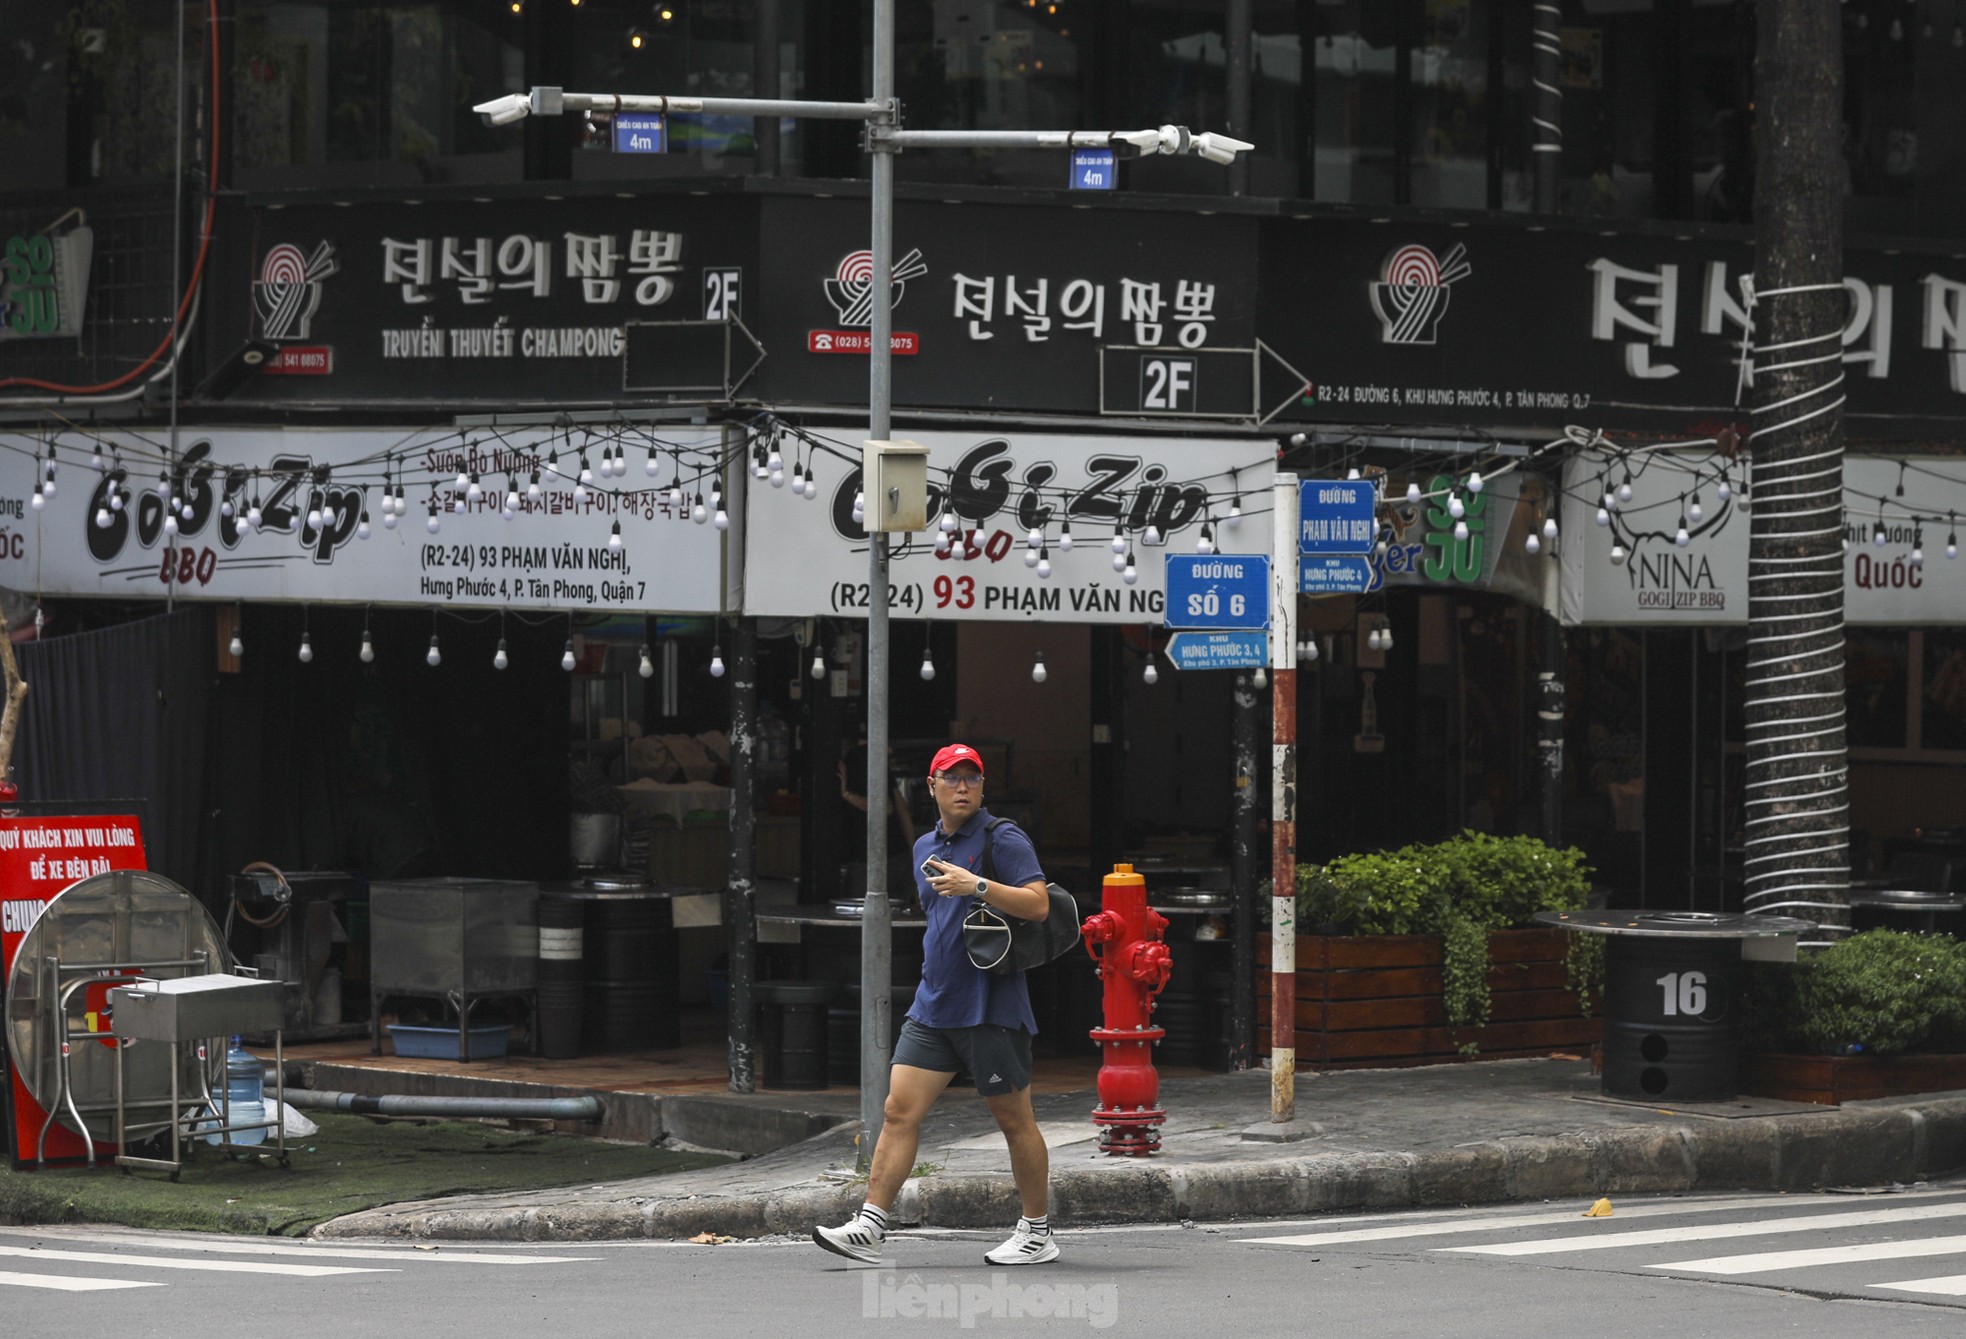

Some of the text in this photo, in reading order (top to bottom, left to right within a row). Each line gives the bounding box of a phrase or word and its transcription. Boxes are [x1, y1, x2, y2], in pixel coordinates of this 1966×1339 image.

[630, 133, 652, 150] 4m
[1083, 169, 1103, 186] 4m
[564, 229, 684, 305] 짬뽕
[706, 271, 739, 320] 2F
[1120, 277, 1216, 349] 짬뽕
[382, 315, 626, 358] TRUYỀN THUYẾT CHAMPONG
[836, 336, 862, 349] (028)
[284, 353, 299, 367] 541
[301, 353, 325, 367] 08075
[1144, 360, 1192, 409] 2F
[1318, 385, 1350, 401] R2-24
[1354, 383, 1390, 402] ĐƯỜNG
[1393, 388, 1402, 406] 6,
[1405, 388, 1425, 403] KHU
[1428, 388, 1454, 405] HƯNG
[1457, 387, 1491, 406] PHƯỚC
[1493, 391, 1501, 409] 4,
[1517, 388, 1534, 408] TÂN
[1537, 391, 1568, 409] PHONG
[1574, 393, 1590, 410] Q.7
[1067, 454, 1209, 547] Zip
[1318, 485, 1357, 504] ĐƯỜNG
[256, 453, 366, 566] Zip
[1303, 516, 1371, 547] PHẠM VĂN NGHỊ
[159, 546, 217, 587] BBQ
[421, 542, 631, 576] (R2-24) 93 PHẠM VĂN NGHỊ,
[1192, 560, 1244, 579] ĐƯỜNG
[1305, 566, 1362, 581] HƯNG PHƯỚC 4
[1640, 553, 1724, 590] NINA
[1855, 553, 1923, 591] Quốc
[421, 576, 646, 604] Hưng Phước 4, P. Tân Phong, Quận 7
[831, 581, 923, 614] (R224)
[933, 574, 976, 610] 93
[985, 586, 1060, 616] PHẠM
[1070, 582, 1121, 612] VĂN
[1188, 585, 1245, 616] SỐ 6
[1638, 591, 1726, 608] GOGI ZIP BBQ
[1182, 642, 1260, 658] HƯNG PHƯỚC 3, 4
[1209, 635, 1229, 643] KHU
[1183, 659, 1196, 667] Khu
[1241, 658, 1260, 668] Phong
[0, 823, 136, 851] QUÝ KHÁCH XIN VUI LÒNG
[30, 853, 47, 880] ĐỂ
[48, 860, 64, 880] XE
[67, 856, 90, 878] BÊN
[1656, 971, 1707, 1016] 16
